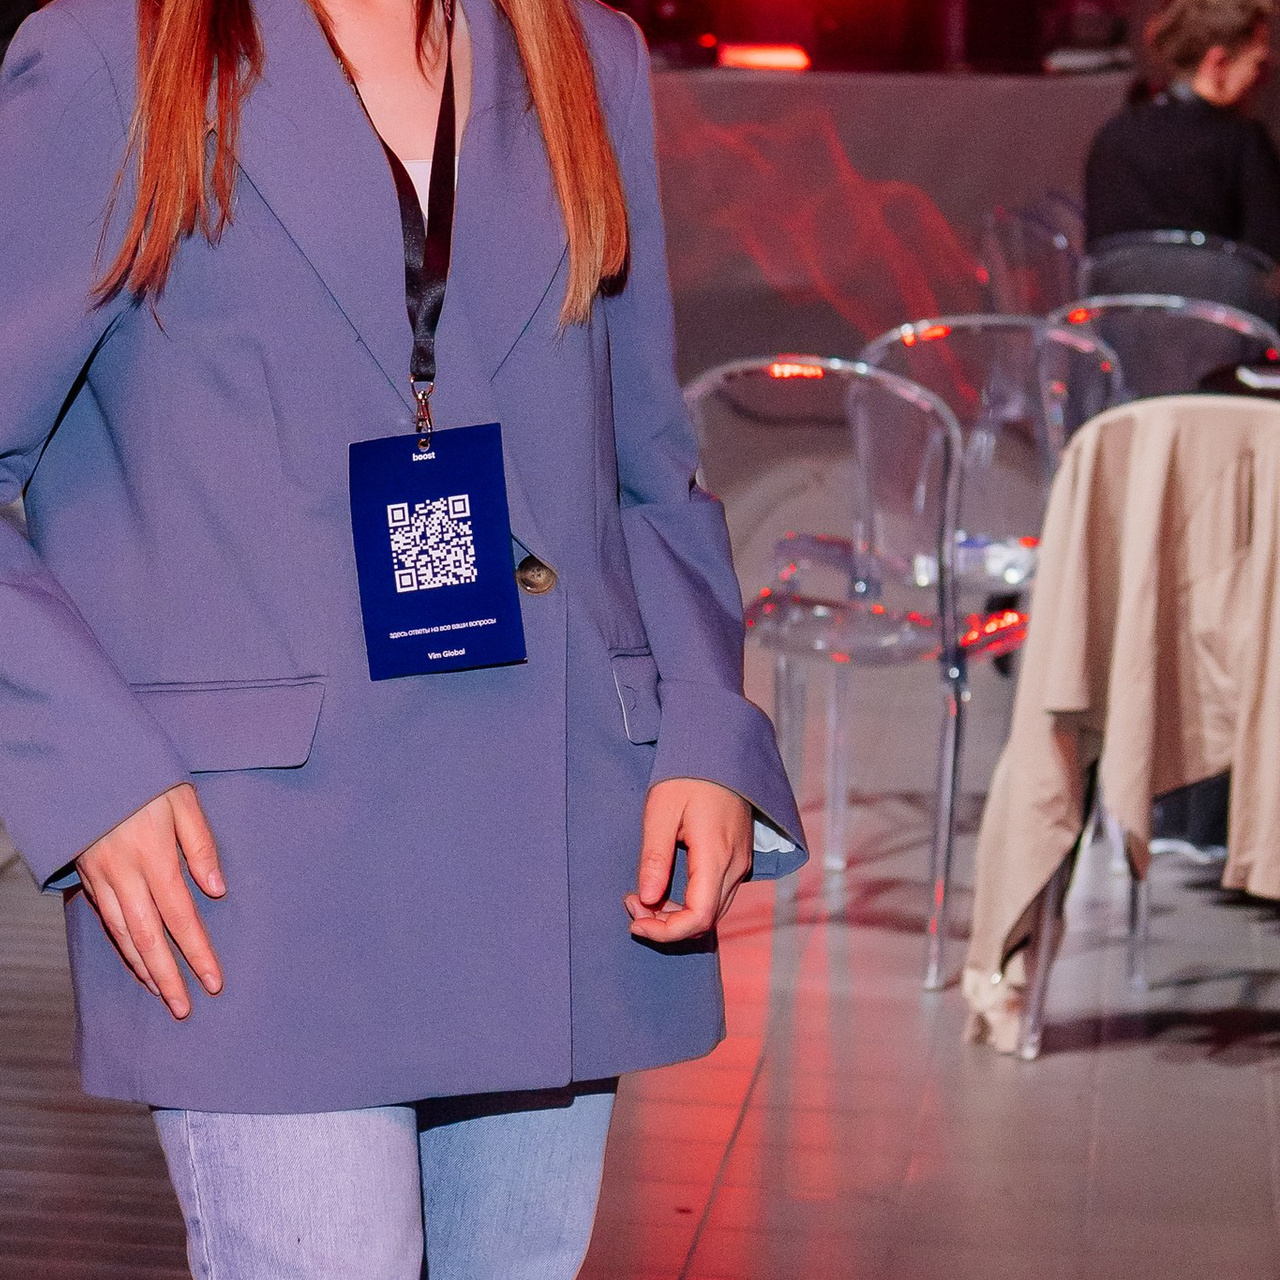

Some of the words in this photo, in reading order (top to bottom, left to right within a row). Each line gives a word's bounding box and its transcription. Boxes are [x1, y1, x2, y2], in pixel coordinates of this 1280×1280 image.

[412, 451, 436, 461] boost
[389, 631, 408, 639] здесь
[469, 618, 496, 627] вопросы
[428, 652, 442, 660] Vim
[442, 647, 466, 658] Global
